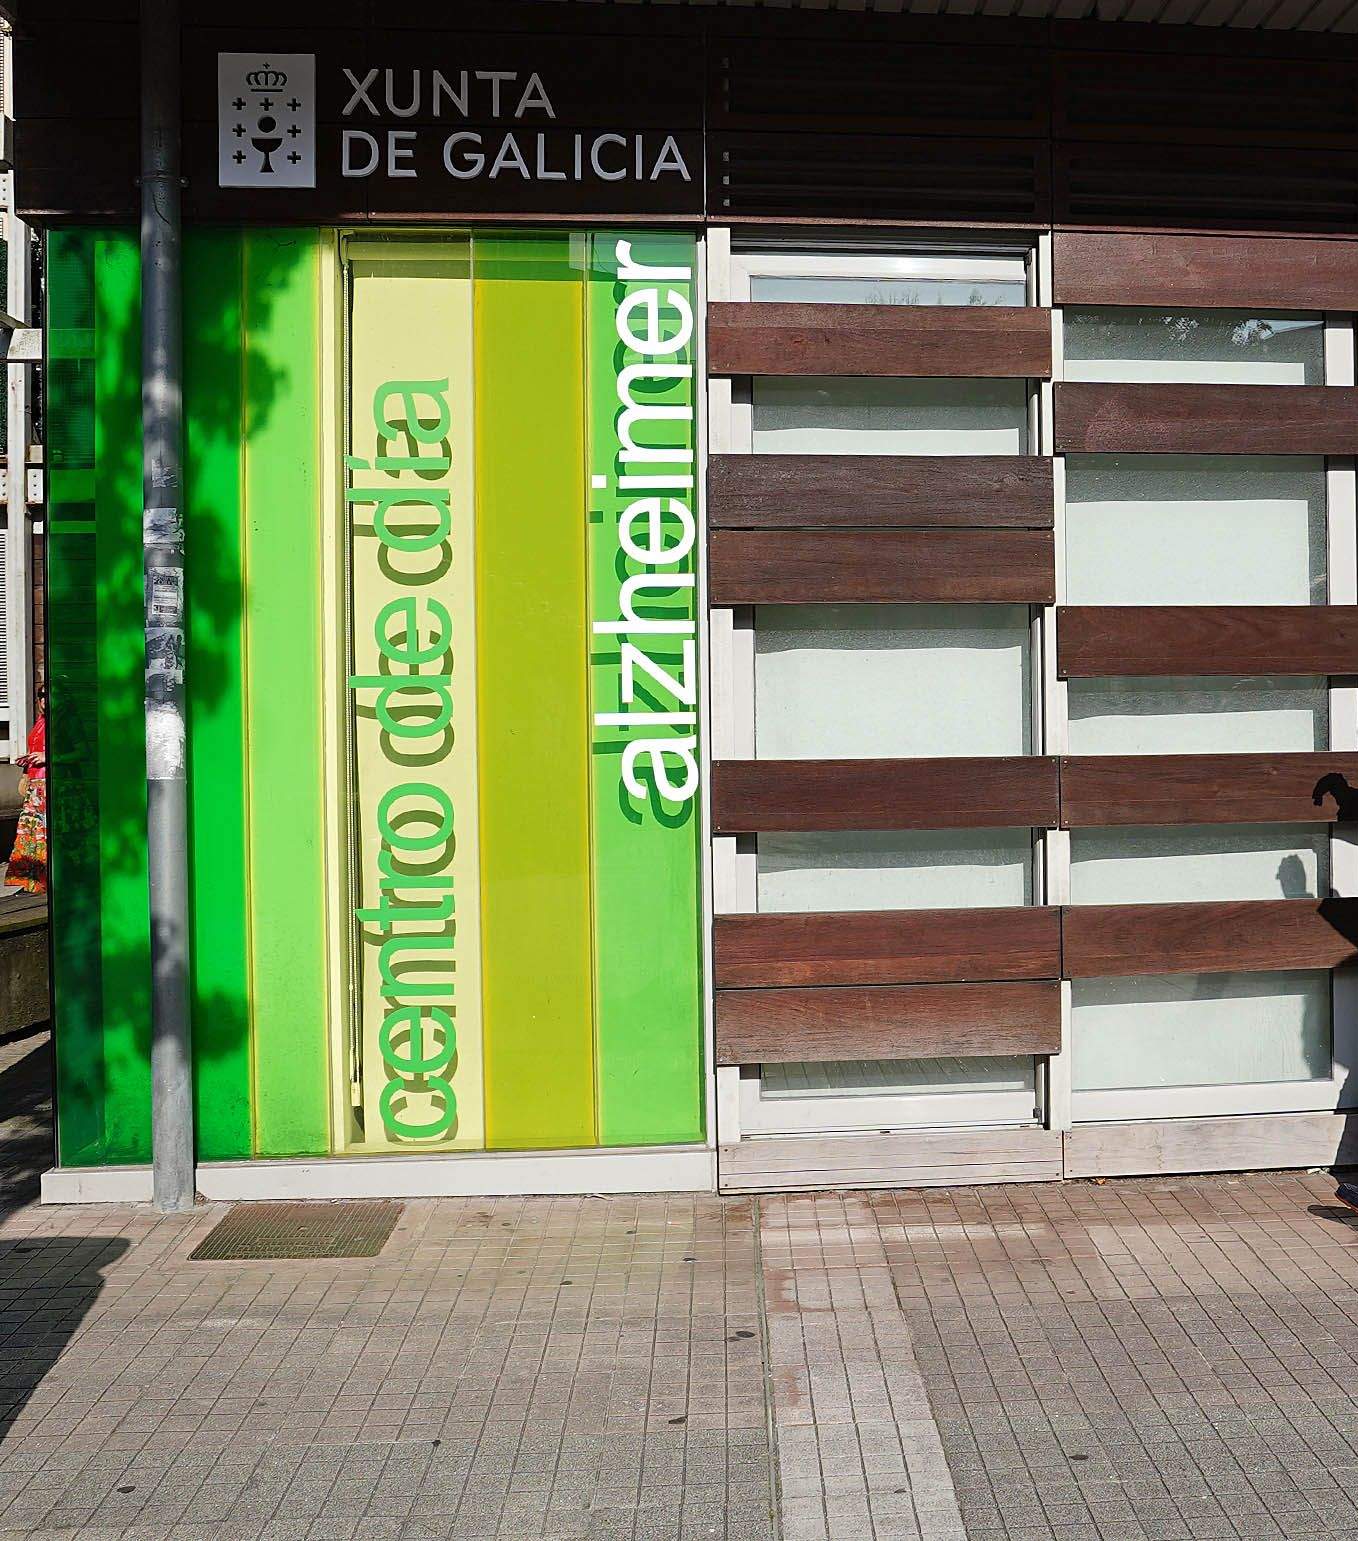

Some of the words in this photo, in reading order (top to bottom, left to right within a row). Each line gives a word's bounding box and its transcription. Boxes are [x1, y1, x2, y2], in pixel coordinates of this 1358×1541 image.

[342, 68, 556, 118] XUNTA
[342, 130, 418, 178] DE
[443, 131, 692, 181] GALICIA
[344, 377, 452, 552] día
[591, 239, 699, 801] alzheimer
[349, 597, 454, 738] de
[355, 782, 457, 1138] centro
